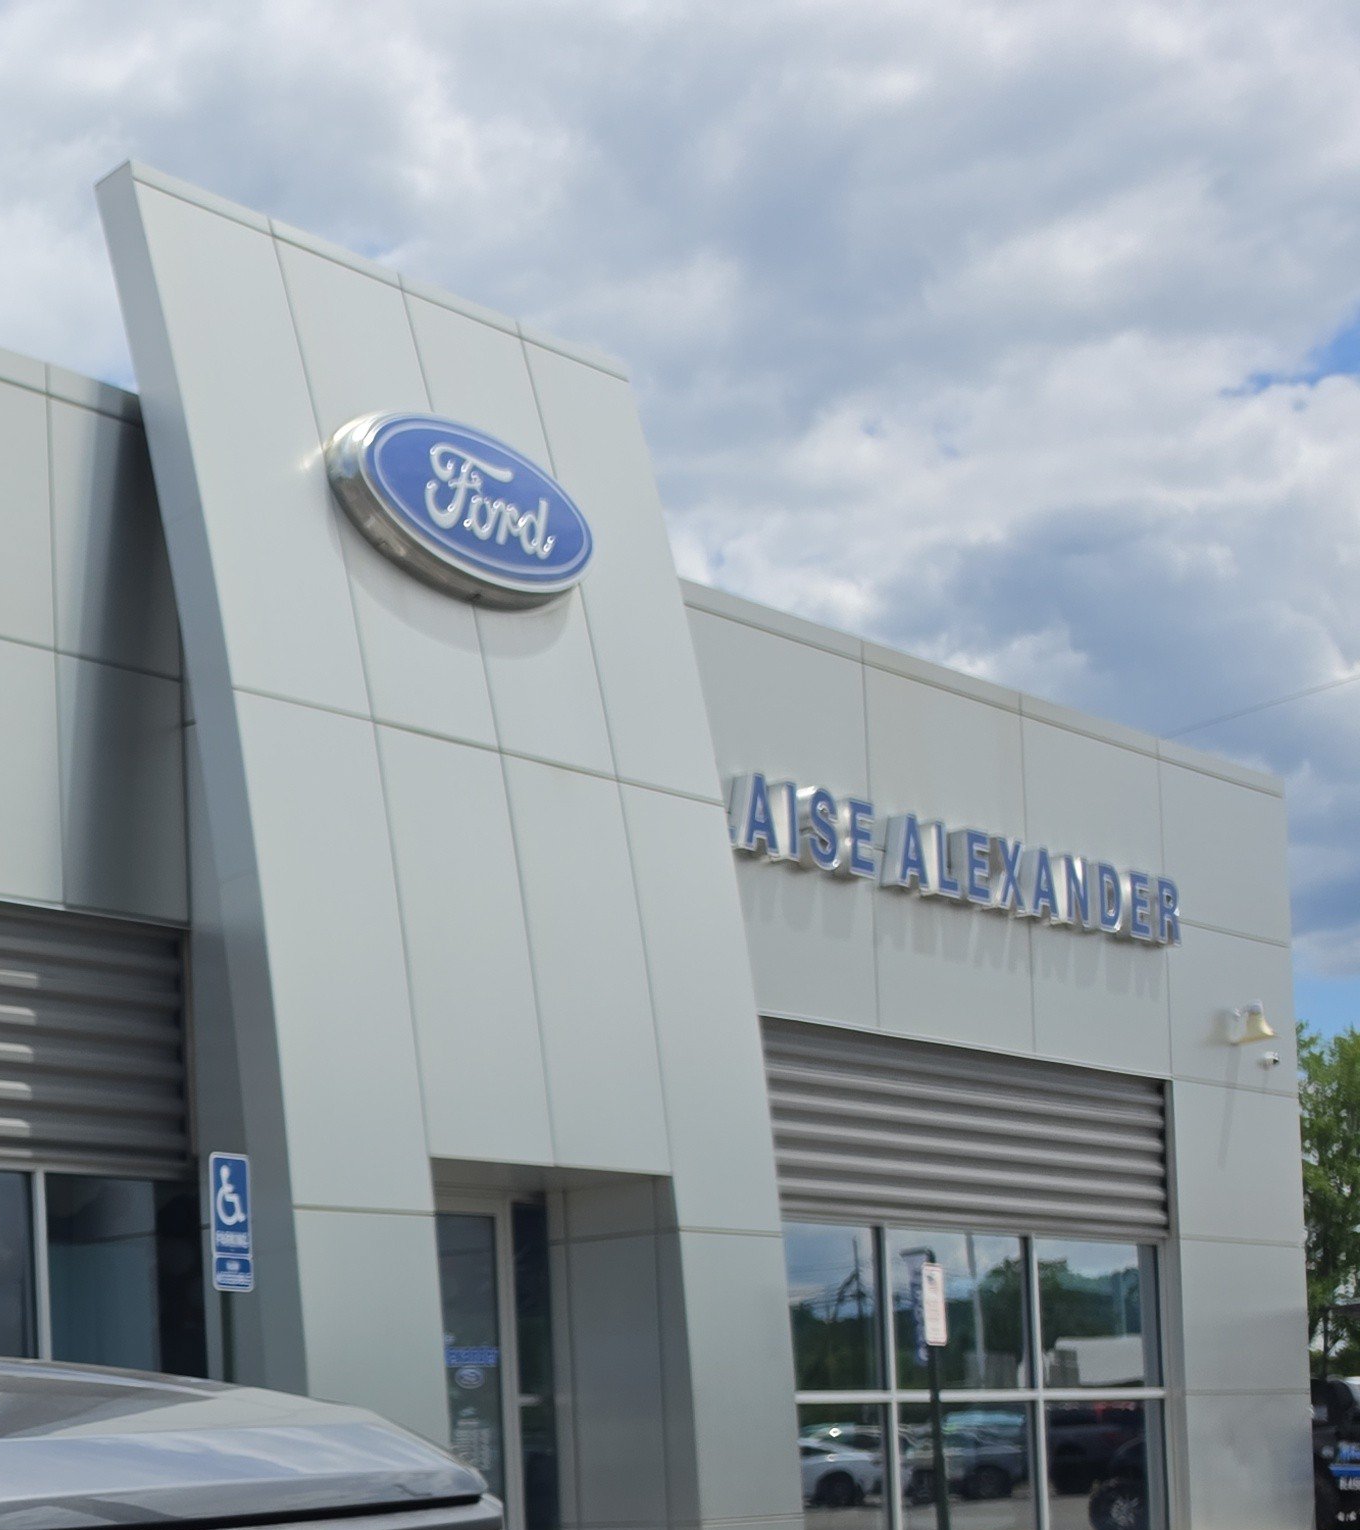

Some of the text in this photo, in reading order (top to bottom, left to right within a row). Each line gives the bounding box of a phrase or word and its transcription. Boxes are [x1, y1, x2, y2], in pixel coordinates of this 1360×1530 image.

[424, 442, 556, 559] Ford
[729, 773, 1180, 947] AISE ALEXANDER
